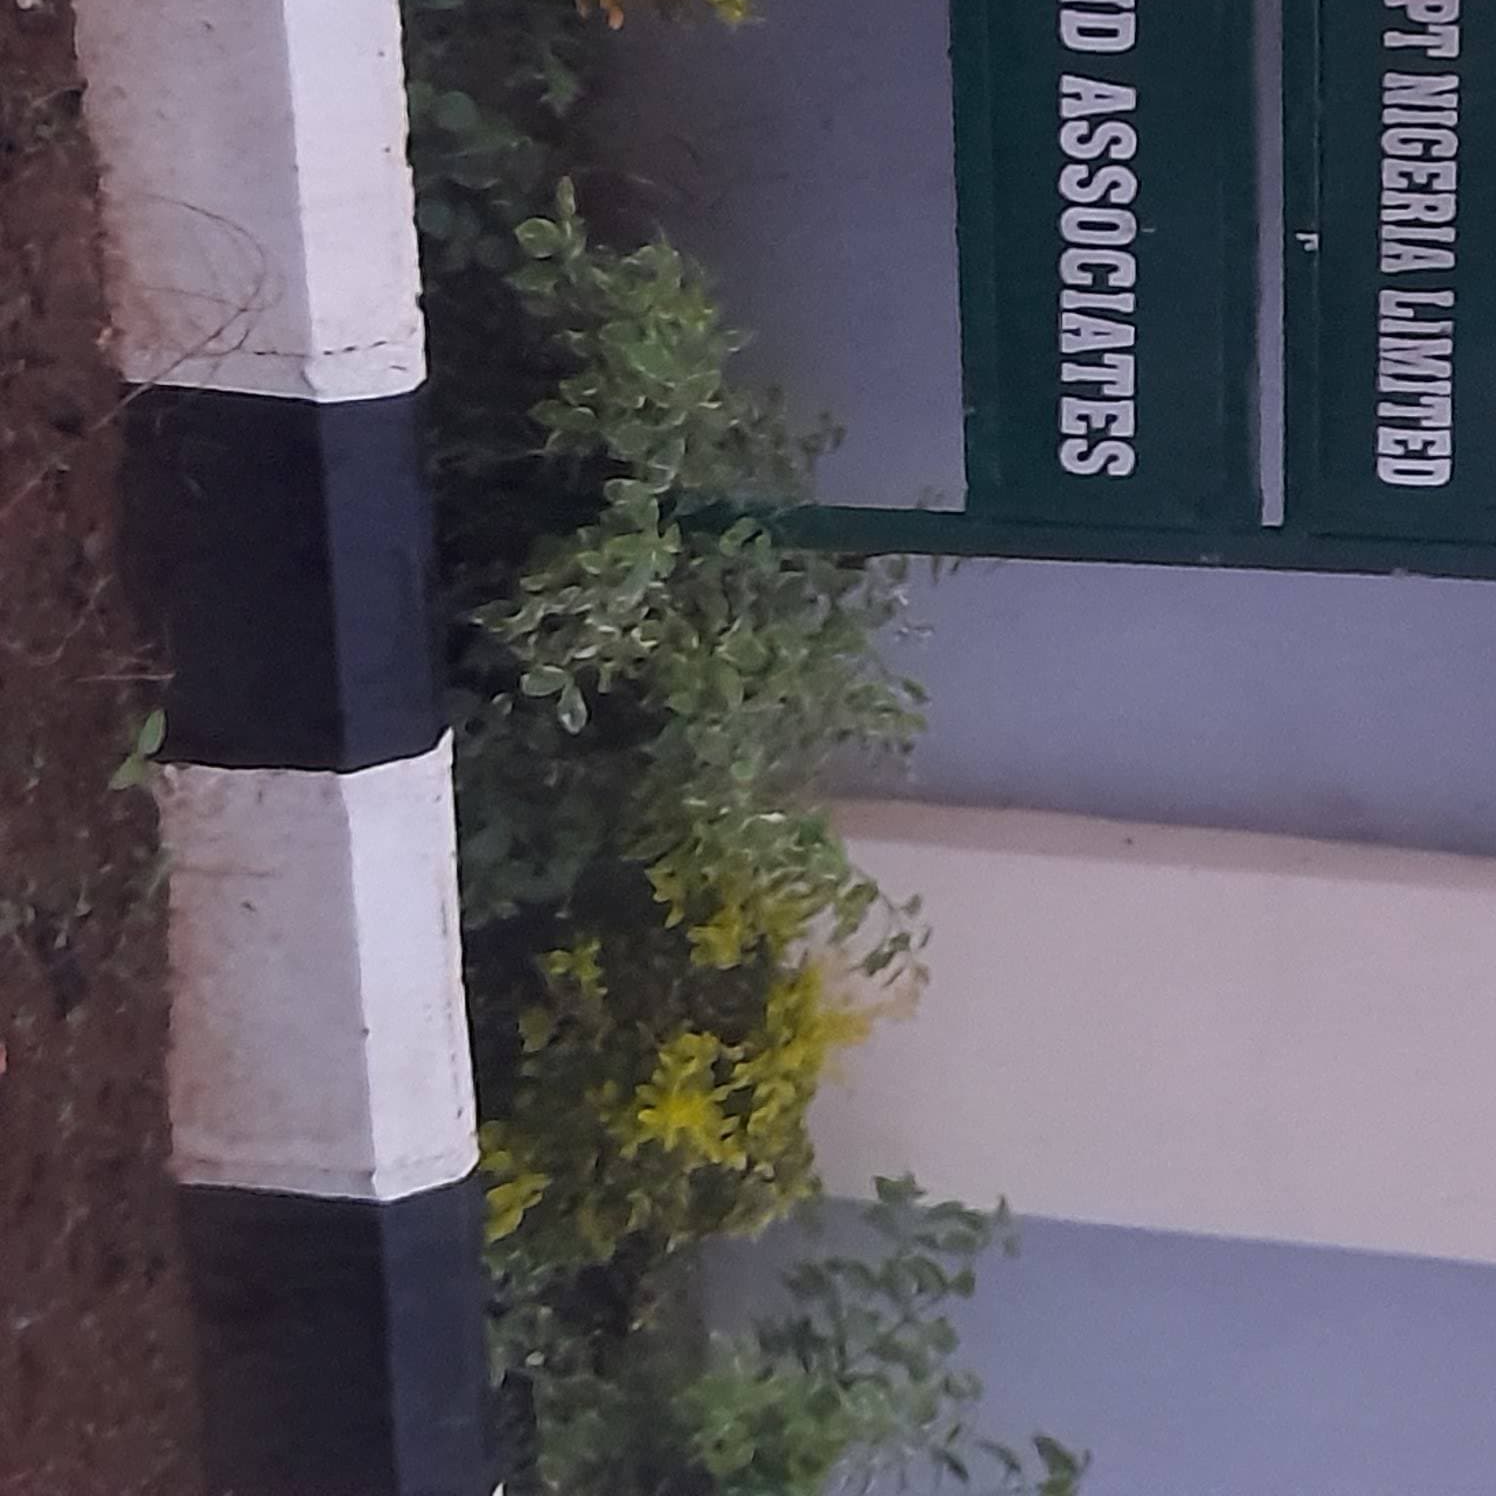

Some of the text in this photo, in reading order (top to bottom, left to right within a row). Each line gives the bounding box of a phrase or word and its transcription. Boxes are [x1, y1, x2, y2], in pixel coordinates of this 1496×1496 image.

[1380, 73, 1459, 273] NIGERIA
[1058, 74, 1137, 477] ASSOCIATES
[1376, 290, 1454, 487] LIMITED
